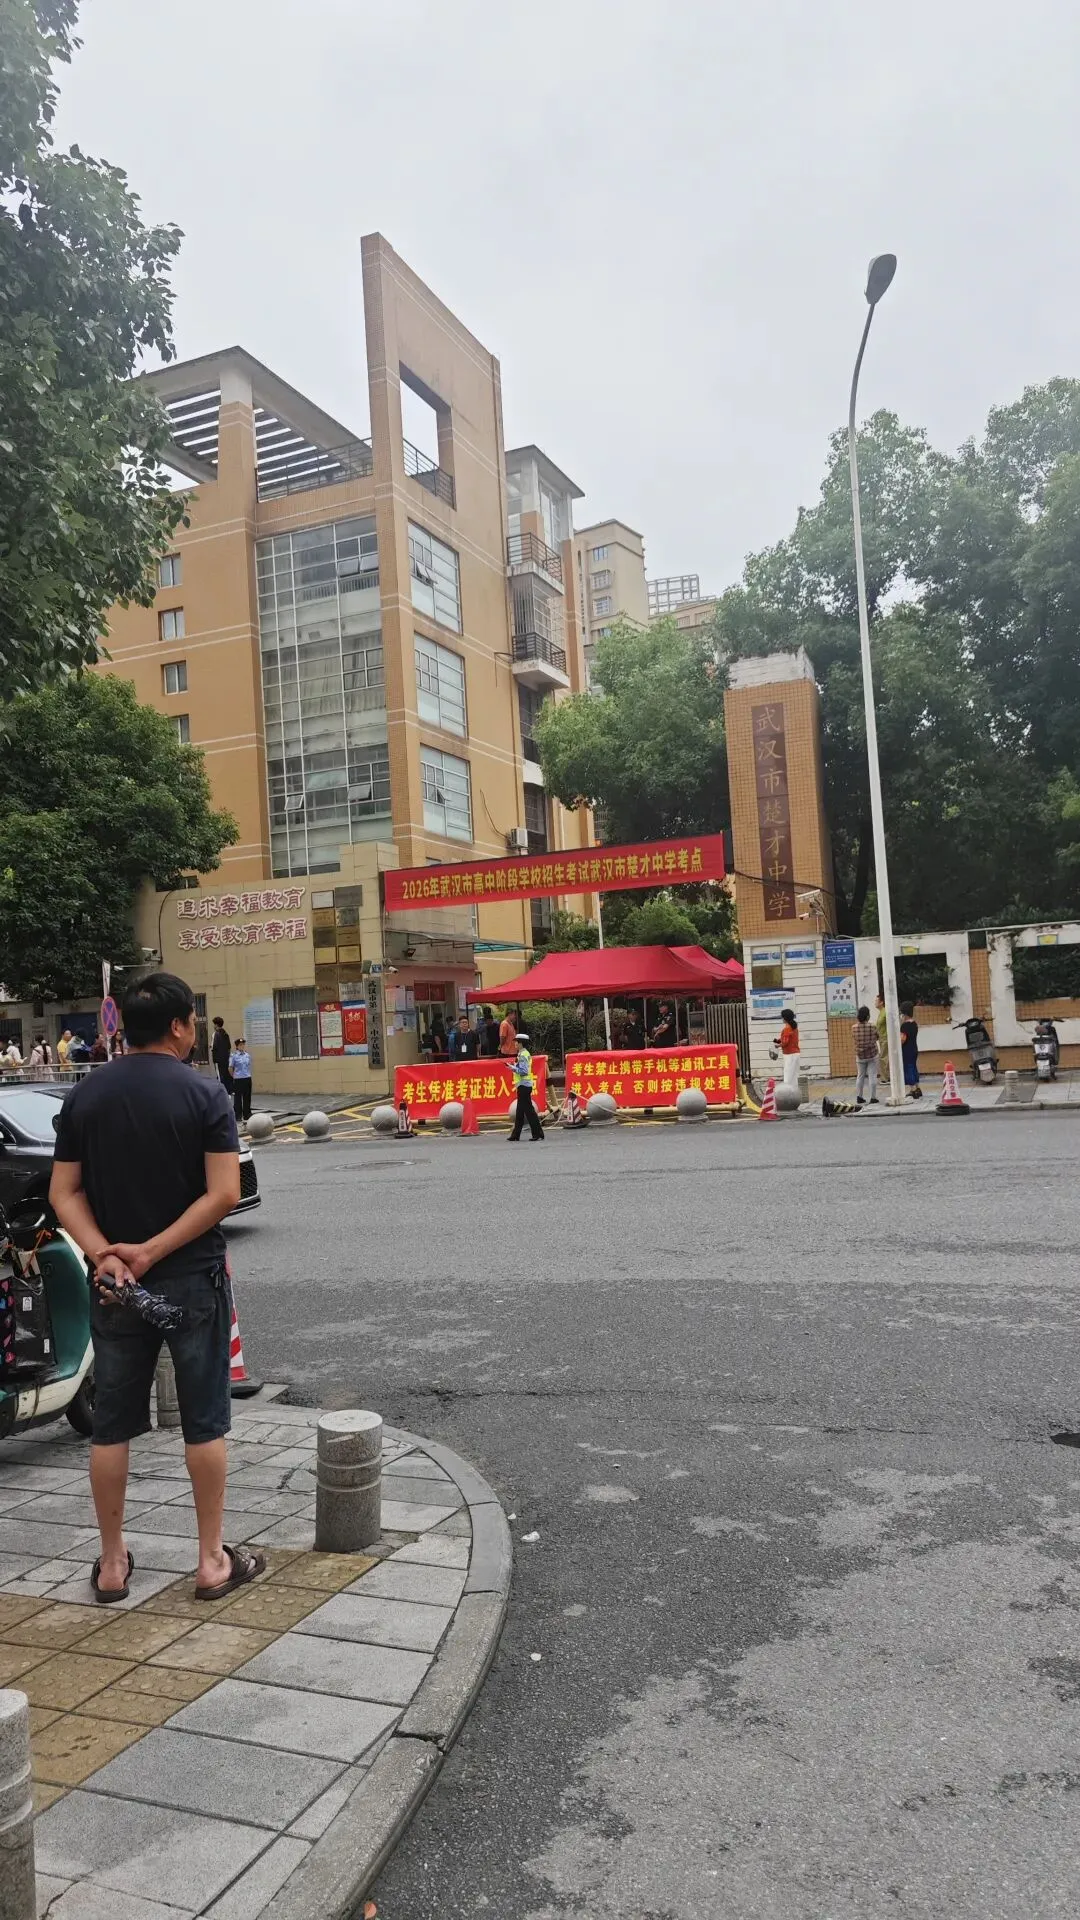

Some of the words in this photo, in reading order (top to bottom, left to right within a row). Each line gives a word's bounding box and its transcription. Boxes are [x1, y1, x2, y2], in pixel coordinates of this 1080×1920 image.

[757, 707, 790, 917] 武汉市楚才中学
[402, 847, 703, 899] 2026年武汉市高中阶段学校招生考试武汉市楚才中学考点
[177, 887, 306, 920] 追求幸福教育
[178, 917, 308, 950] 享受教育幸福
[571, 1055, 730, 1077] 考生禁止携带手机等通讯工具
[403, 1072, 538, 1105] 考生凭准考证进入
[571, 1080, 623, 1095] 进入考点
[633, 1076, 730, 1094] 否则按违规处理
